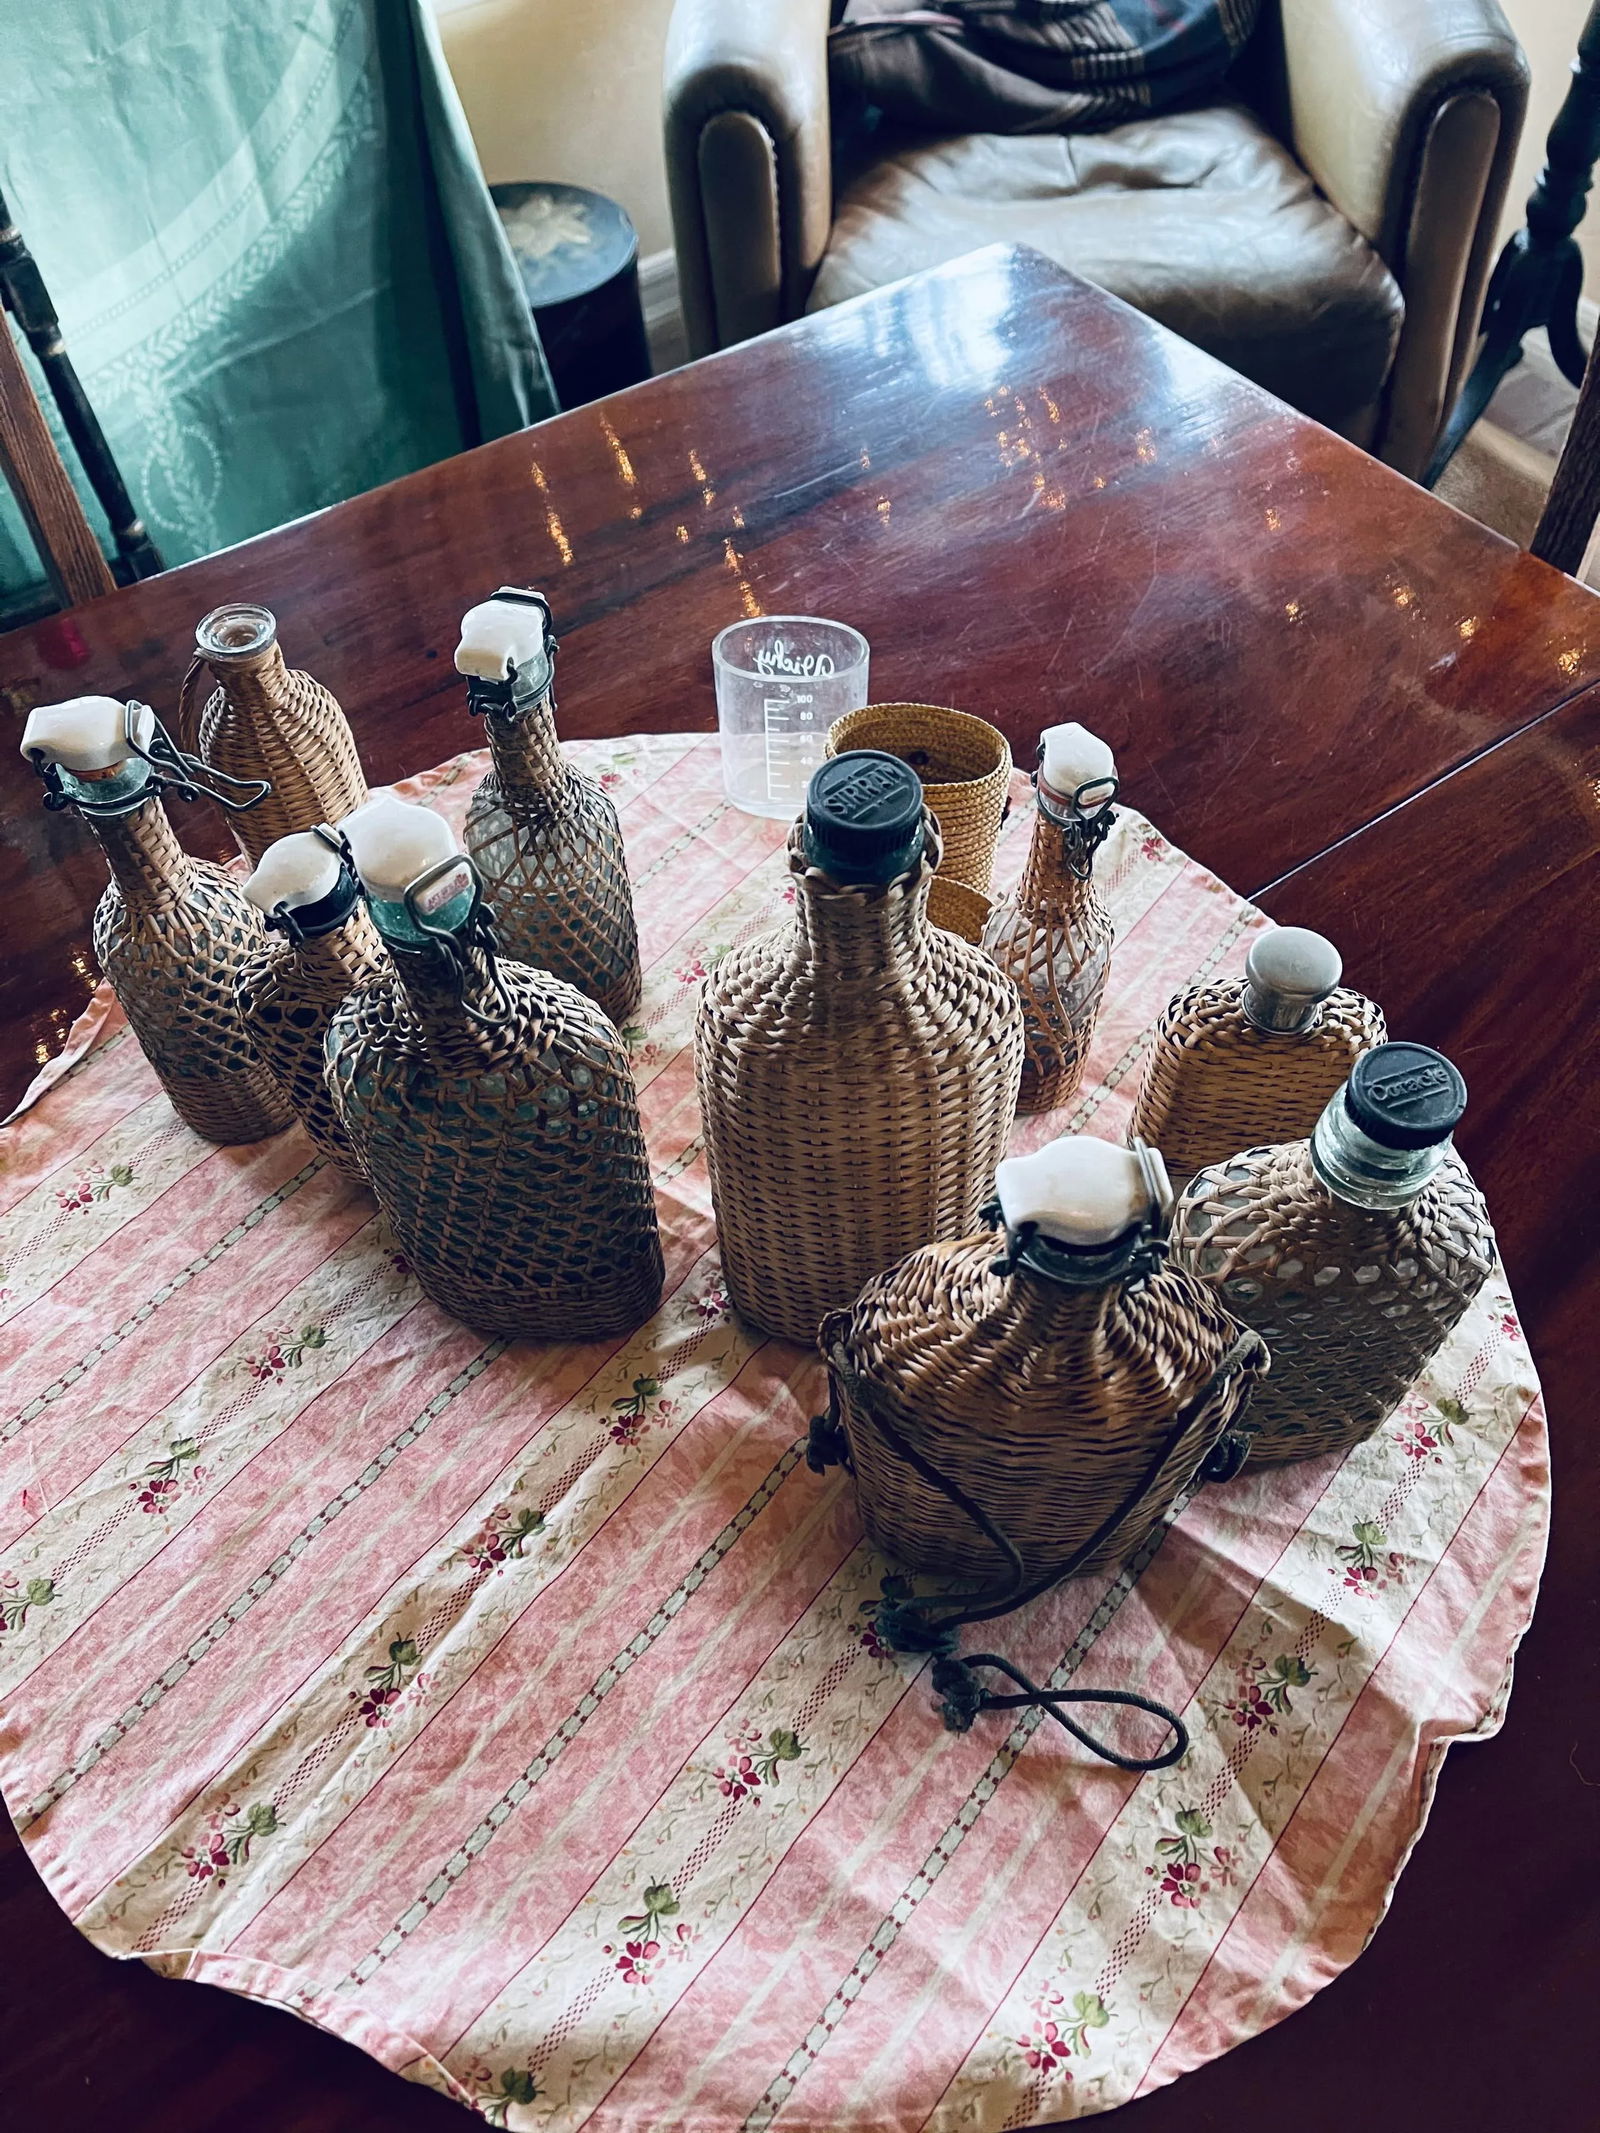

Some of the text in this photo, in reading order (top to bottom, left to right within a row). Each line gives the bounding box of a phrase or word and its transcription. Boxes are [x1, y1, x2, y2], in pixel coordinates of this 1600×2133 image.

[796, 694, 813, 704] 100
[800, 711, 813, 720] 80
[823, 763, 907, 815] SIRRAM
